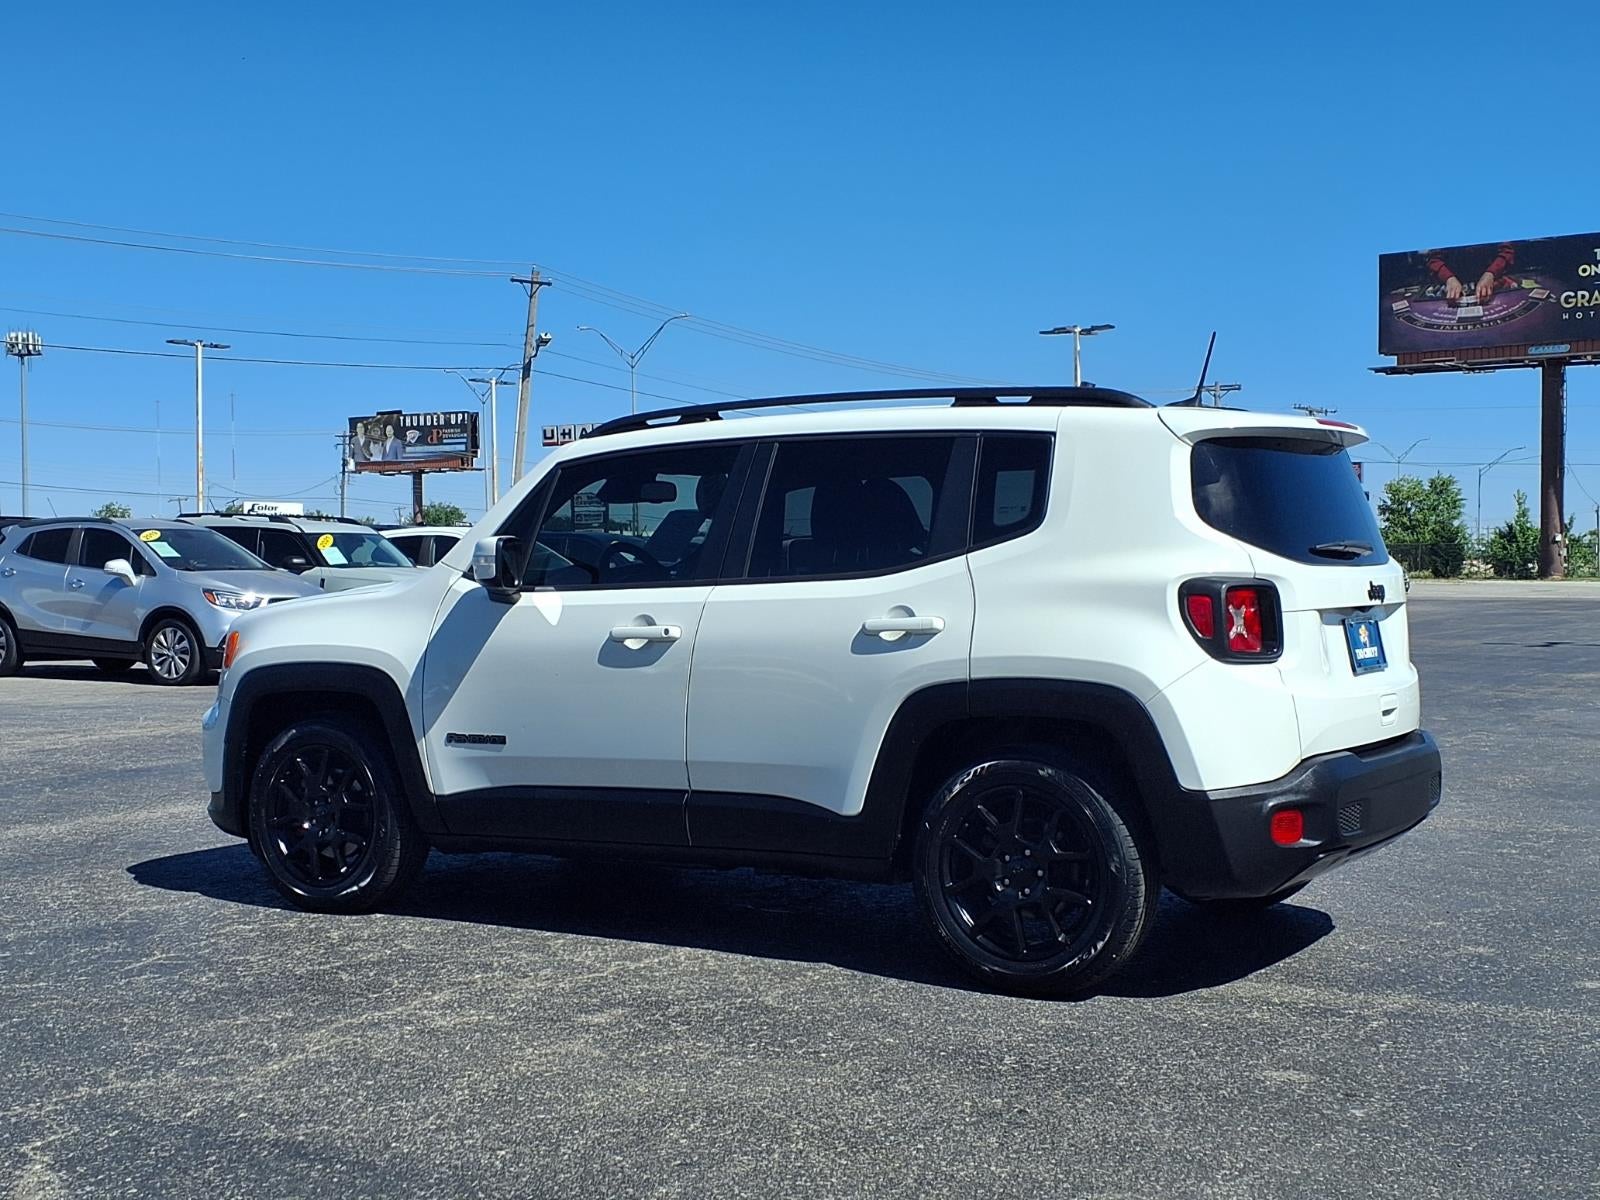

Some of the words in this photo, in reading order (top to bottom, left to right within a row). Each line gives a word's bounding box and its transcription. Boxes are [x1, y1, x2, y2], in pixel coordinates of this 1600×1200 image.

[400, 414, 445, 427] THUNDER
[450, 412, 468, 424] UP!
[446, 733, 507, 745] RENEGADE
